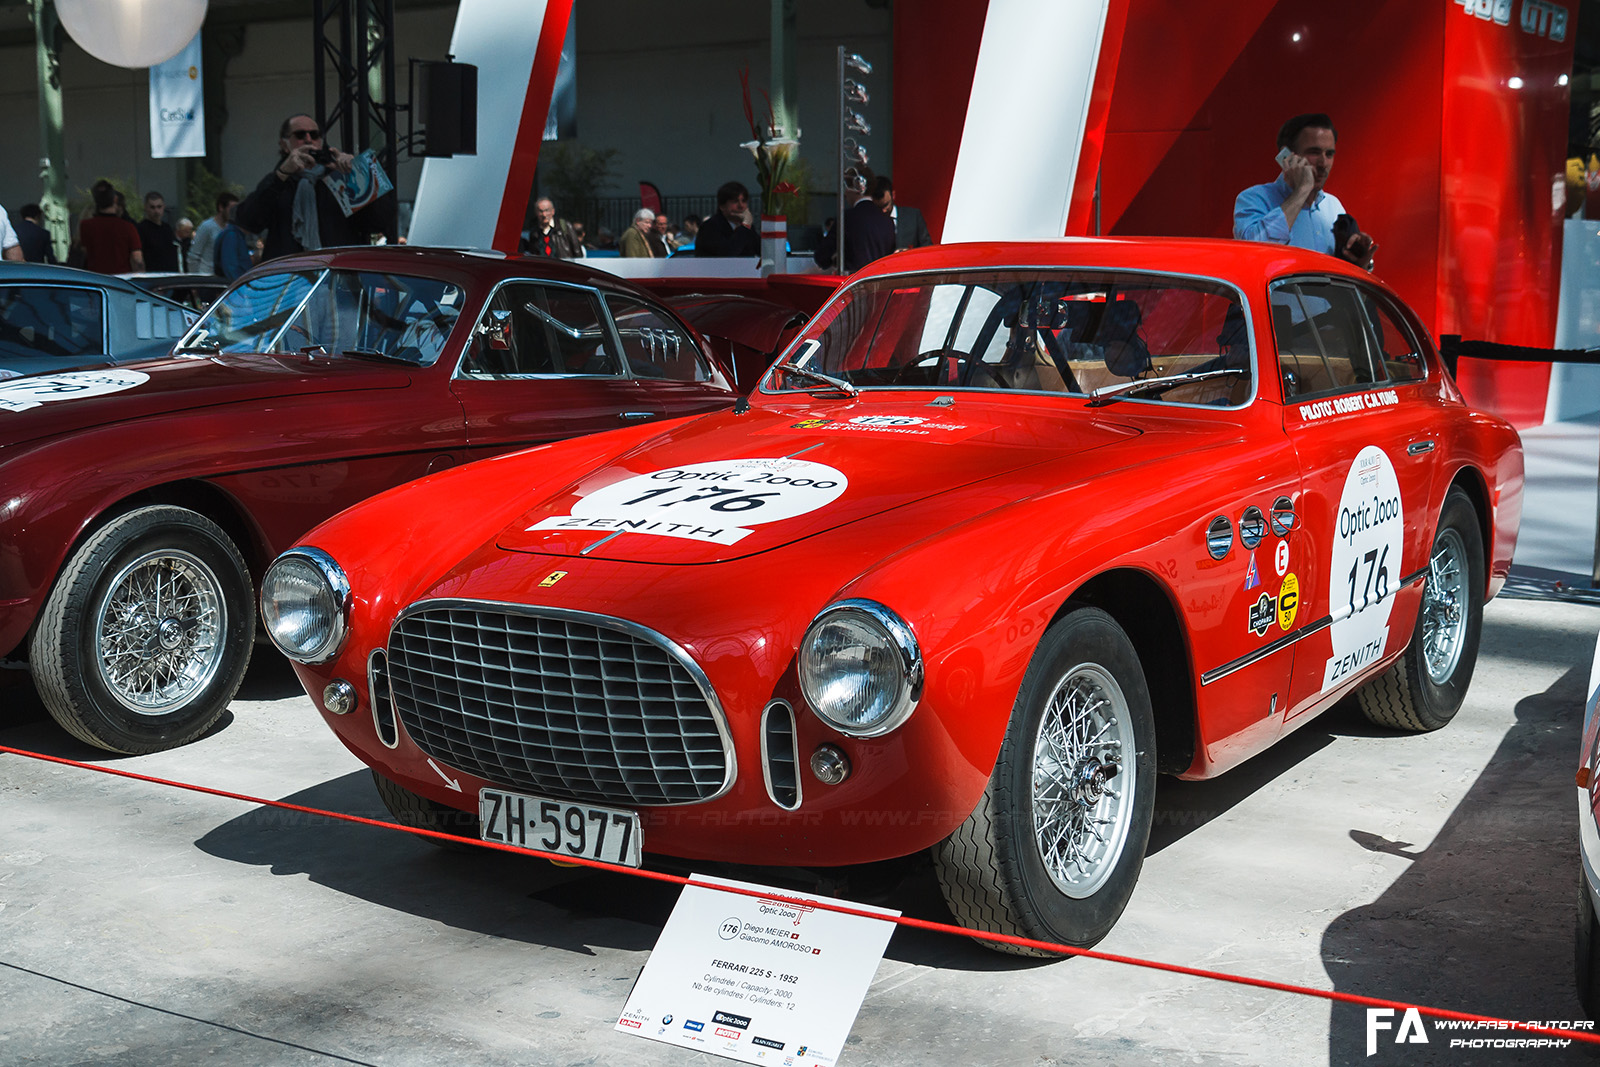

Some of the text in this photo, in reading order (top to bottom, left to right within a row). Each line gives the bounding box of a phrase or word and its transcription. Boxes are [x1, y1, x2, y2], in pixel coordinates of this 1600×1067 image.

[1521, 0, 1568, 42] GTB
[1333, 395, 1365, 414] ROBERT
[859, 416, 914, 425] 176
[651, 470, 838, 489] Optic 2000
[622, 486, 780, 512] 176
[557, 518, 724, 538] ZENITH
[1340, 496, 1398, 546] Optic 2000
[1279, 545, 1285, 571] E
[1347, 544, 1389, 619] 176
[1280, 592, 1297, 611] C
[1331, 637, 1382, 682] ZENITH
[760, 905, 796, 919] Optic 2000
[722, 924, 738, 934] 176
[744, 922, 790, 938] Diego MEIER
[740, 933, 812, 954] Giacomo AMOROSO
[711, 959, 748, 973] FERRARI
[749, 968, 764, 977] 225
[765, 970, 772, 979] S
[779, 974, 799, 984] 1952
[692, 982, 702, 990] Nb
[713, 986, 743, 1000] cylindres
[749, 994, 784, 1008] Cylinders:
[785, 1002, 795, 1010] 12
[703, 973, 736, 987] Cylindrée
[741, 981, 772, 995] Capacity:
[774, 989, 792, 999] 3000
[624, 1012, 650, 1021] ZENITH
[733, 1017, 748, 1026] 2000
[716, 1028, 740, 1039] MOTUL
